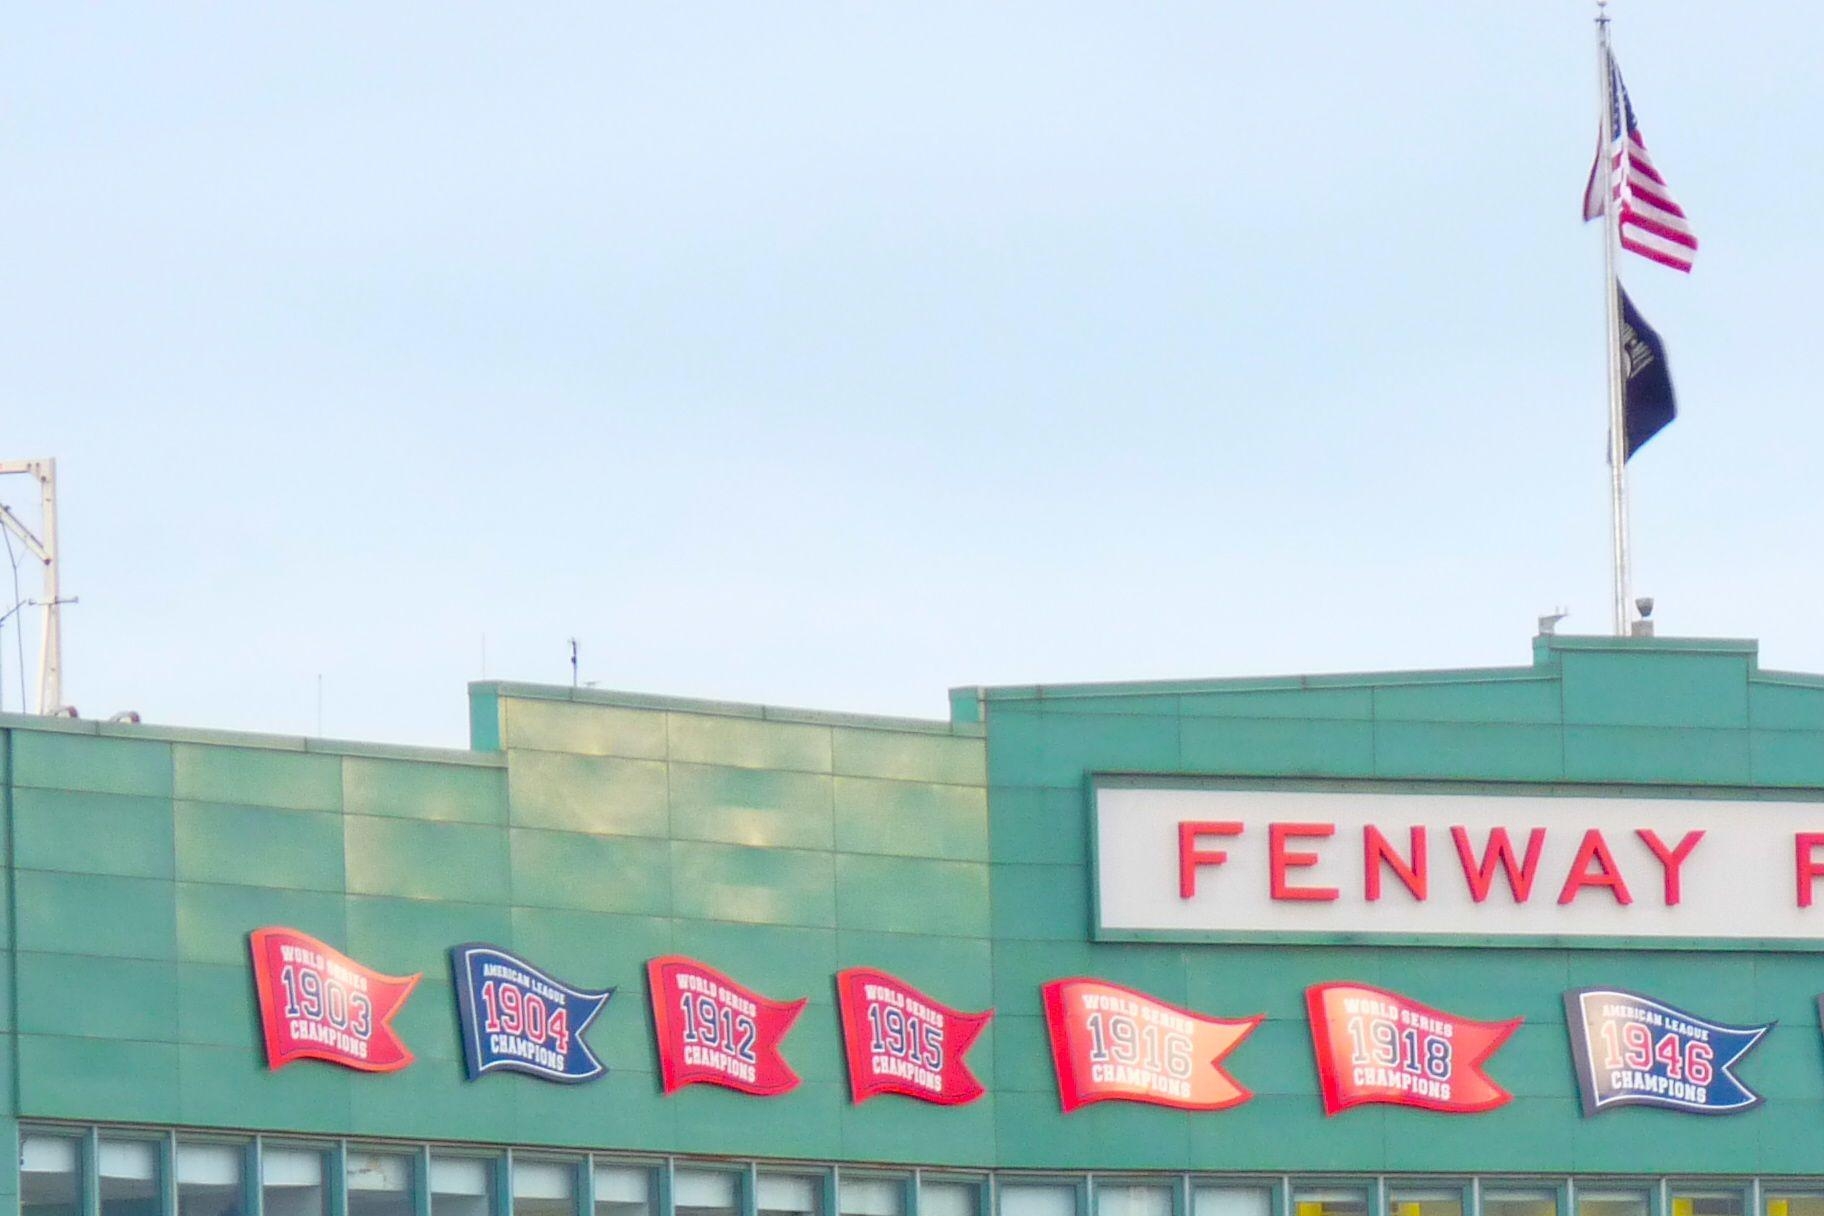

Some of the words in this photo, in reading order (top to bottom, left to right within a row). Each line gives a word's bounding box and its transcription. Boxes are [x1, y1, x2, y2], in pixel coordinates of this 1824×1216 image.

[1178, 822, 1706, 904] FENWAY
[281, 945, 324, 970] WORLD
[282, 965, 372, 1039] 1903
[484, 963, 530, 987] AMERICAN
[532, 980, 565, 1005] LEAGUE
[676, 973, 717, 998] WORLD
[718, 987, 756, 1017] SERIES
[482, 980, 568, 1054] 1904
[864, 984, 904, 1008] WORLD
[906, 997, 943, 1027] SERIES
[1081, 994, 1138, 1016] WORLD
[1344, 998, 1398, 1020] WORLD
[1401, 1010, 1453, 1037] SERIES
[1602, 1004, 1662, 1026] AMERICAN
[1665, 1017, 1709, 1040] LEAGUE
[290, 1019, 367, 1058] CHAMPIONS
[681, 992, 756, 1064] 1912
[868, 1003, 943, 1072] 1915
[1087, 1012, 1193, 1078] 1916
[490, 1034, 564, 1071] CHAMPIONS
[684, 1046, 755, 1083] CHAMPIONS
[1348, 1016, 1452, 1081] 1918
[1601, 1020, 1713, 1086] 1946
[872, 1056, 942, 1092] CHAMPIONS
[1092, 1063, 1190, 1098] CHAMPIONS
[1353, 1067, 1451, 1100] CHAMPIONS
[1611, 1070, 1706, 1103] CHAMPIONS
